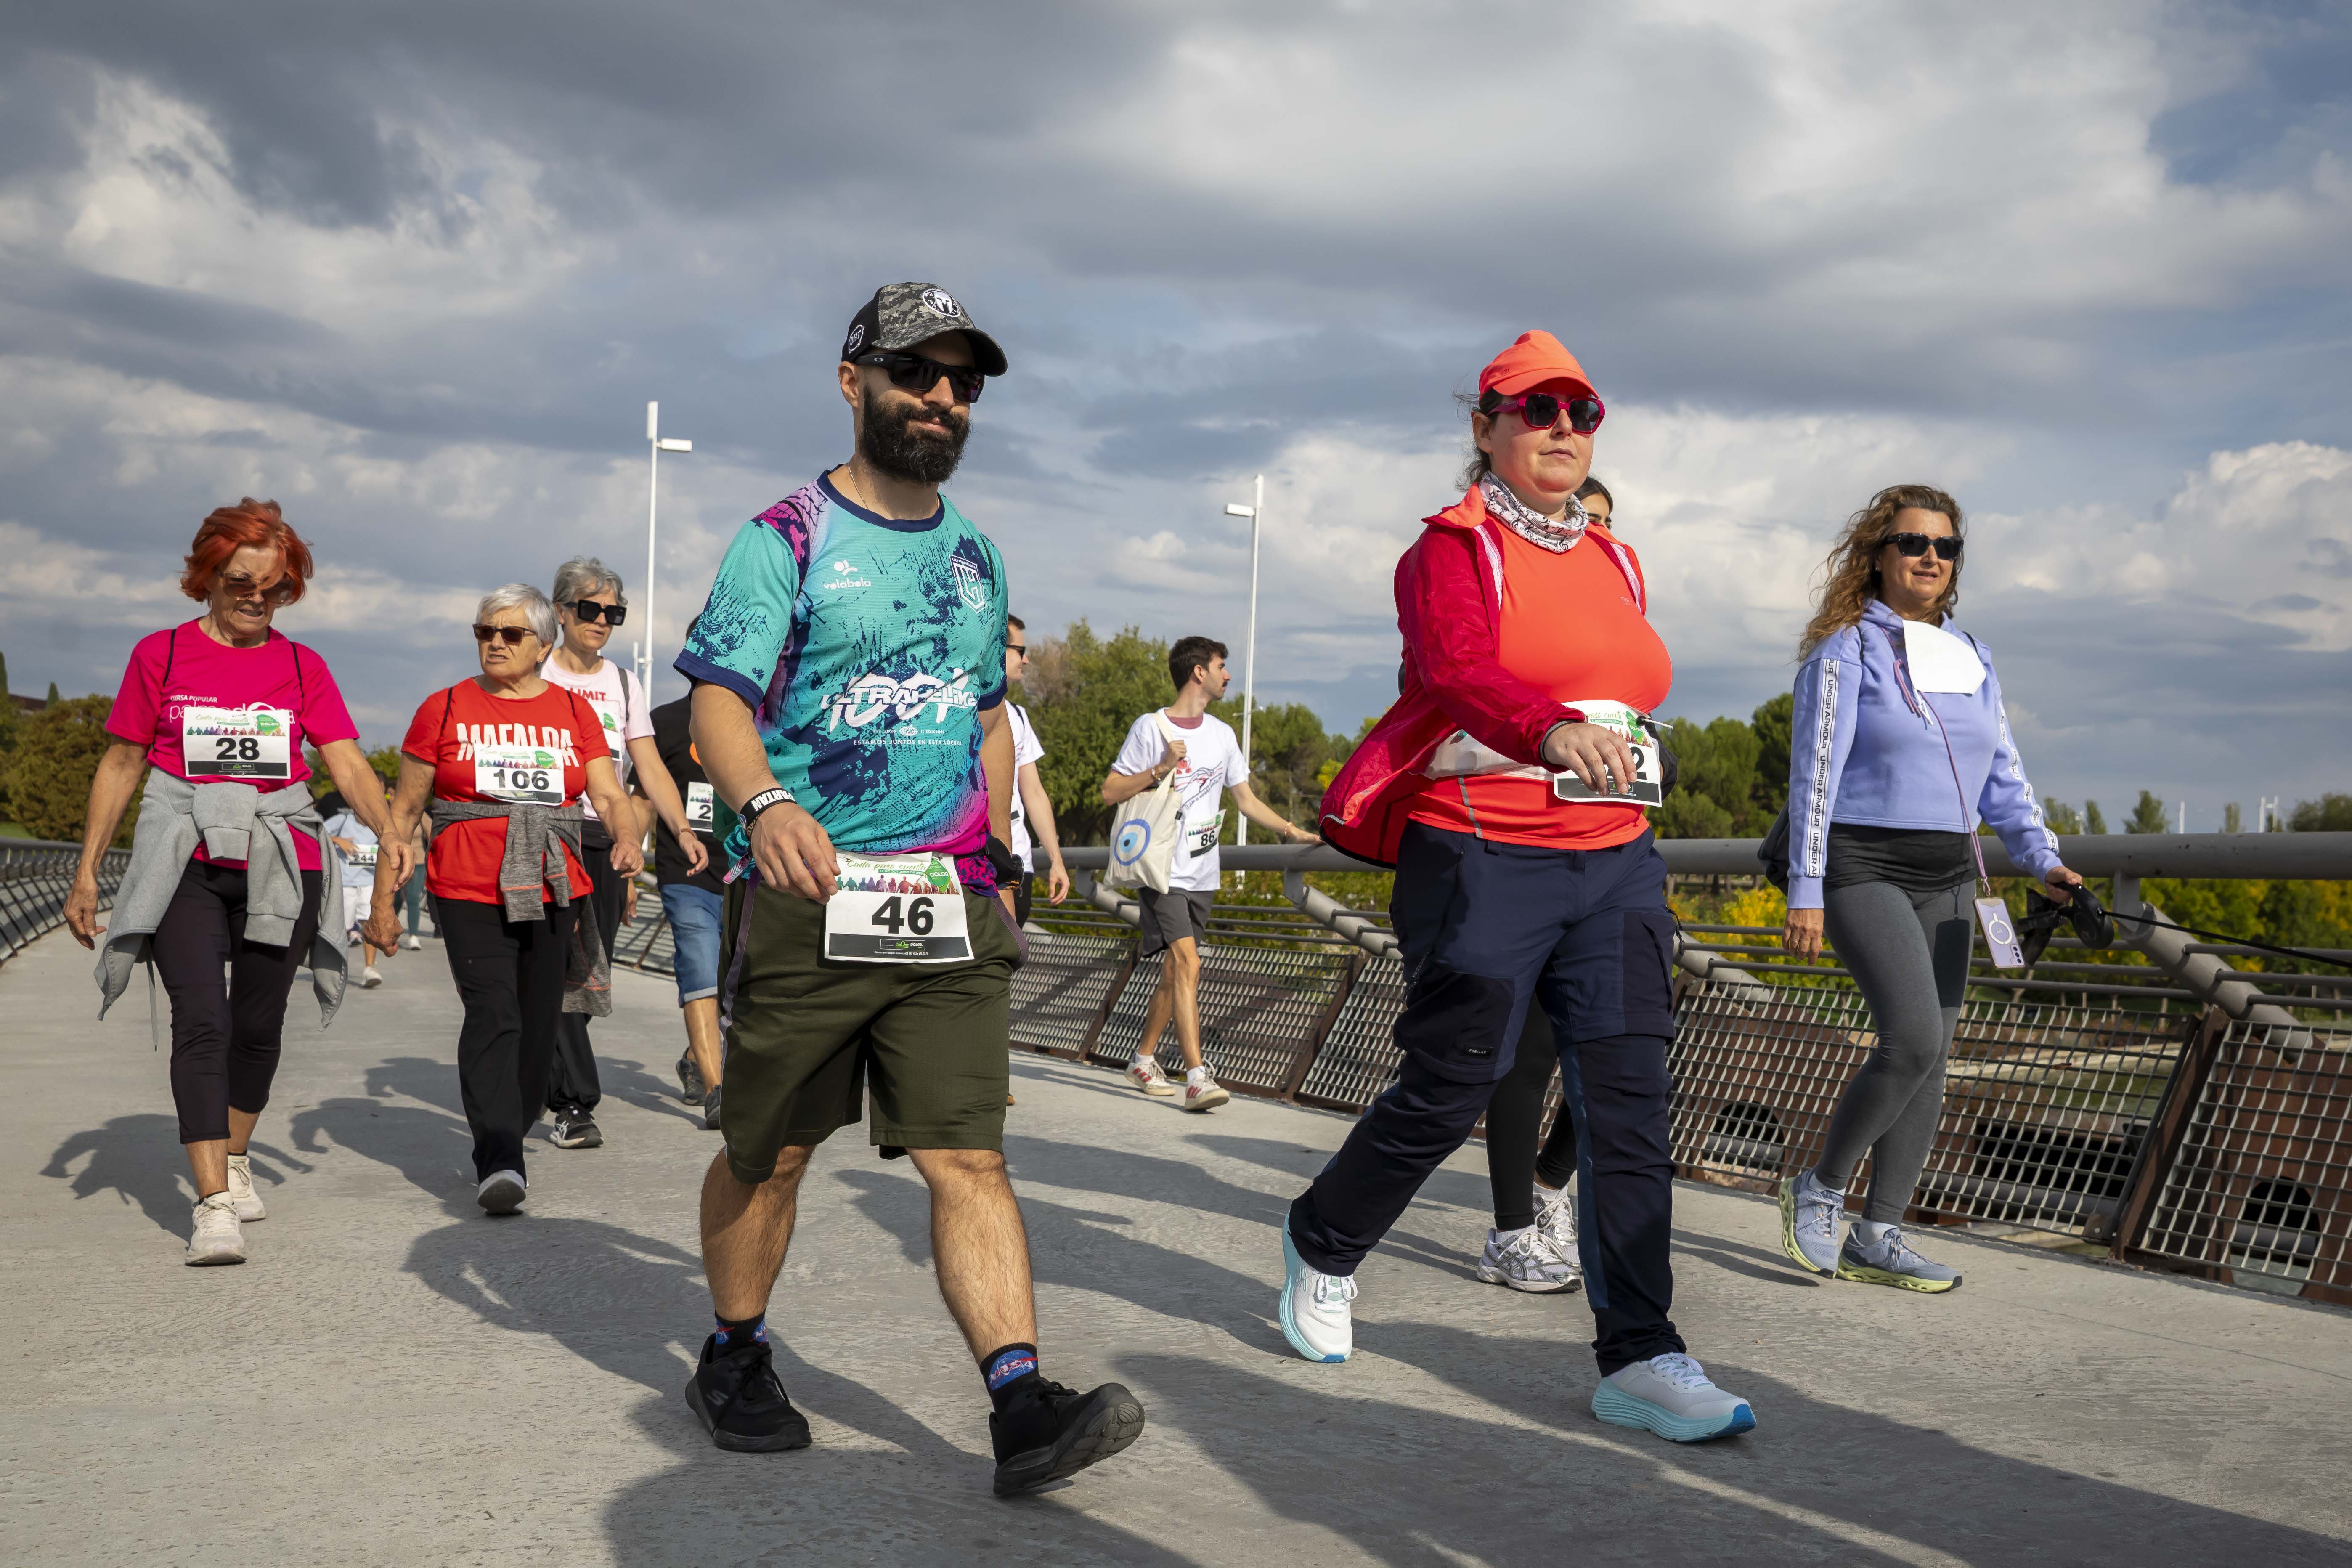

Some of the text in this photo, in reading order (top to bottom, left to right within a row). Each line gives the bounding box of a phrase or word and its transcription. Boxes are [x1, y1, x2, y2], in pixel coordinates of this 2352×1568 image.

[823, 576, 871, 589] volabola
[1821, 711, 1830, 749] ARMOUR
[215, 738, 260, 760] 28
[493, 769, 549, 790] 106
[1817, 756, 1825, 786] UNDER
[751, 790, 796, 811] PARTAN
[1814, 788, 1822, 827] ARMOUR
[1201, 830, 1215, 846] 86
[872, 896, 934, 936] 46
